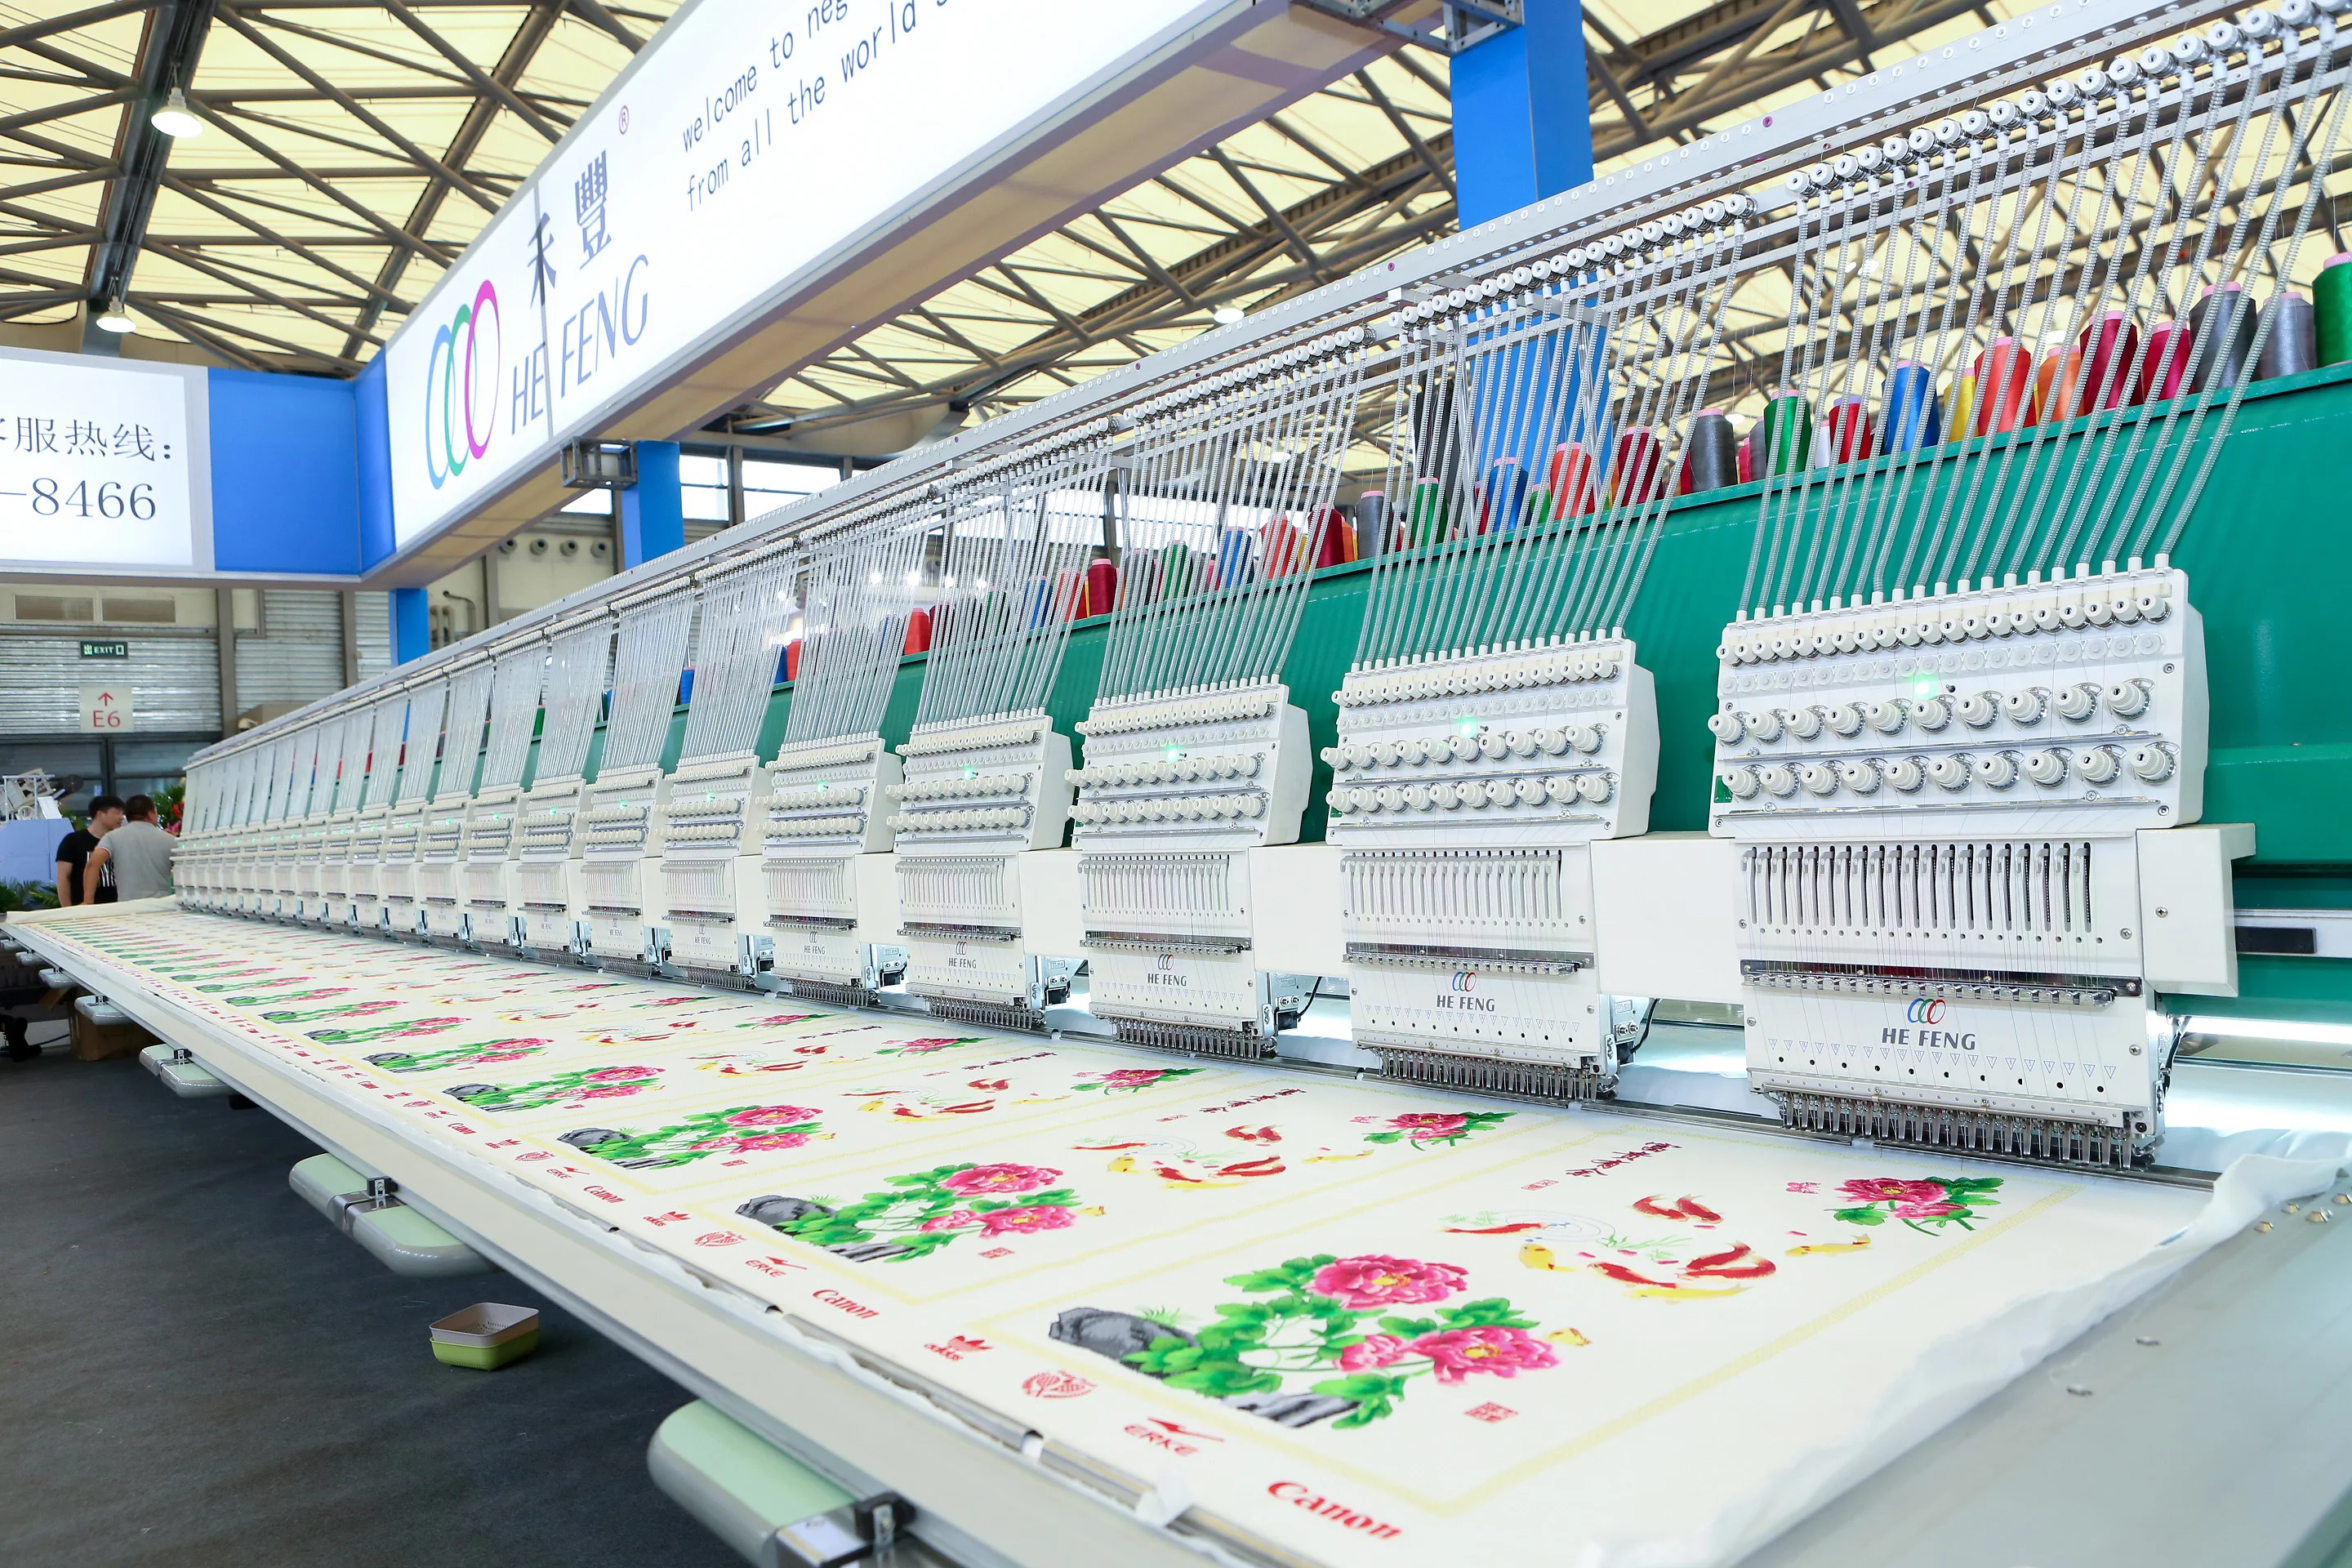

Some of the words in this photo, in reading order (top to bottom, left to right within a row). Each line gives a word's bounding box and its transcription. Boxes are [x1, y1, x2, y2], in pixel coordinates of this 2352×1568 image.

[683, 65, 758, 153] welcome
[769, 31, 794, 69] to
[687, 158, 728, 212] from
[741, 108, 772, 167] all
[787, 75, 826, 125] the
[840, 0, 917, 83] world
[511, 341, 546, 435] HE
[560, 254, 649, 399] FENG
[0, 416, 171, 462] 服热线：
[93, 646, 114, 654] EXIT
[92, 710, 121, 728] E6
[804, 945, 812, 954] HE
[812, 946, 826, 955] FENG
[948, 957, 958, 968] HE
[960, 958, 977, 969] FENG
[1147, 973, 1160, 984] HE
[1163, 974, 1187, 987] FENG
[1437, 994, 1454, 1009] HE
[1459, 996, 1495, 1013] FENG
[1882, 1027, 1909, 1046] HE
[1918, 1029, 1976, 1050] FENG
[583, 1185, 626, 1204] Canon
[745, 1258, 786, 1278] ERKE
[812, 1288, 880, 1320] Canon
[1123, 1423, 1199, 1456] ERKE
[1267, 1479, 1403, 1541] Canon
